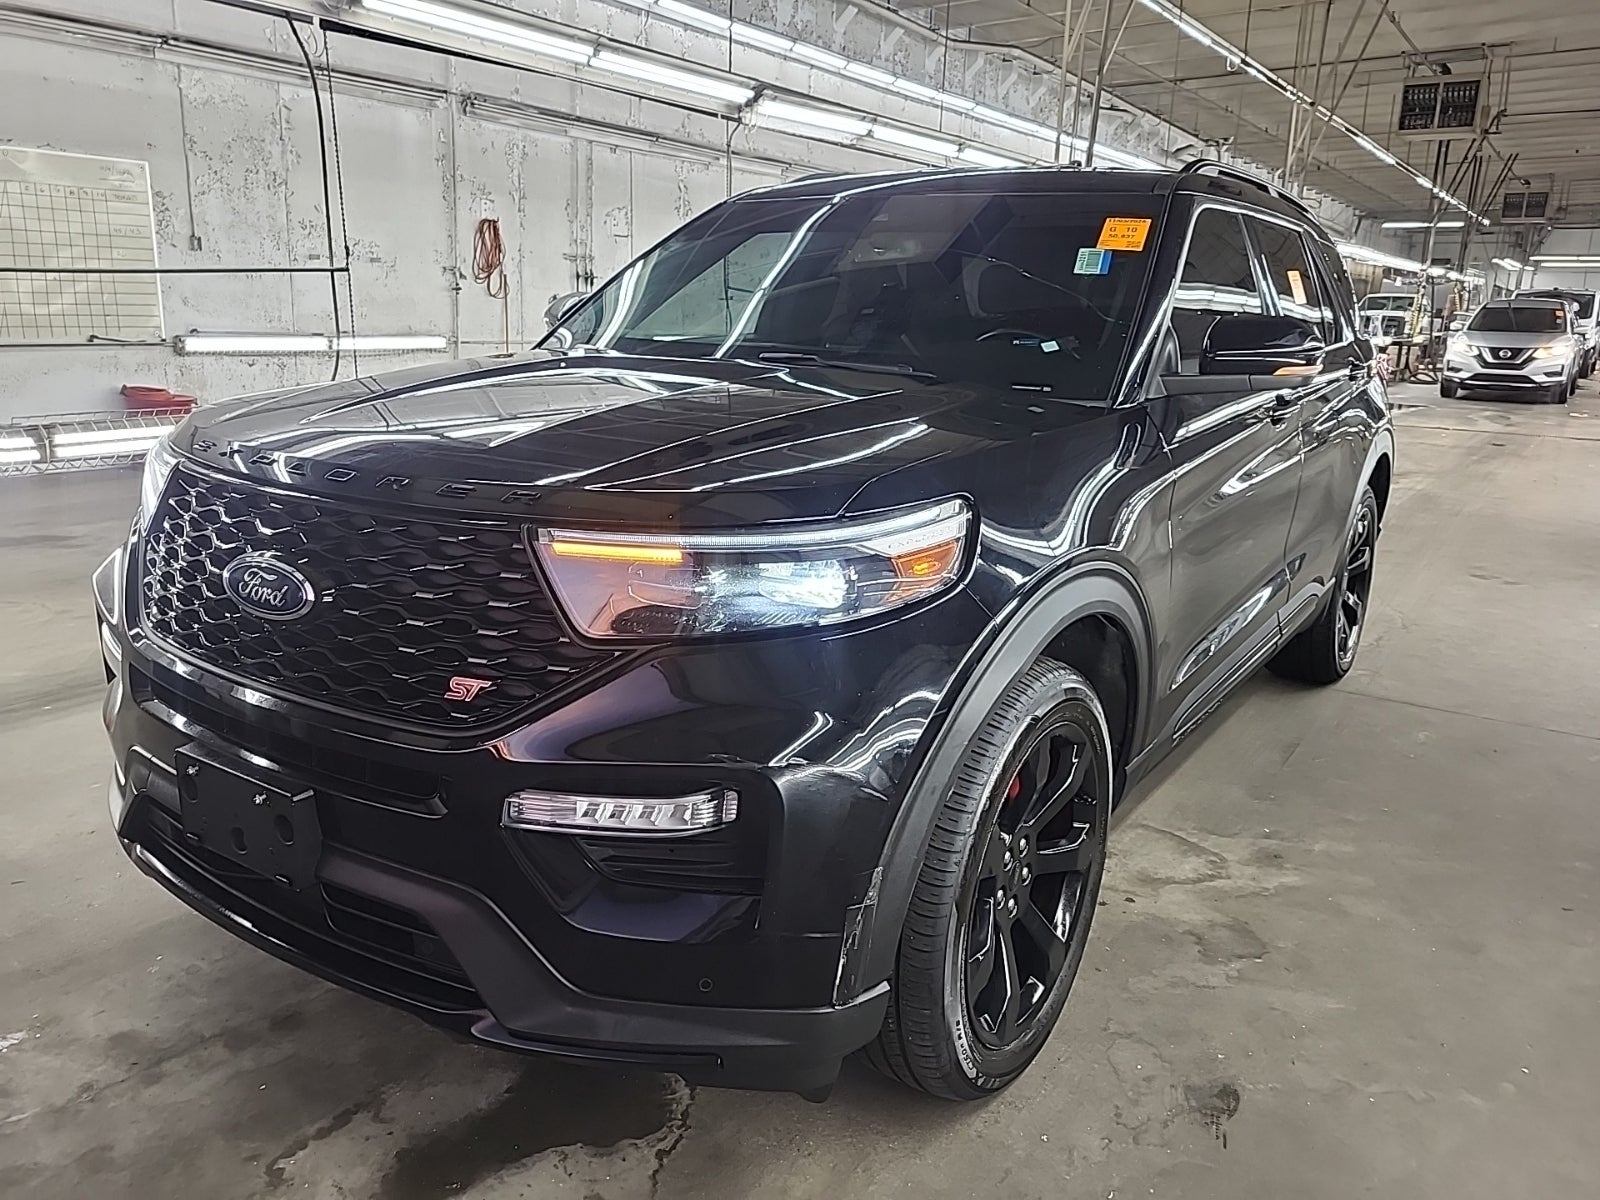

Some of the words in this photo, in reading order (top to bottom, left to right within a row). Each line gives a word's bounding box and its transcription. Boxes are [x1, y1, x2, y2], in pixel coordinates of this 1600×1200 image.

[193, 440, 542, 505] EXPLORER
[239, 567, 289, 608] Ford
[443, 676, 493, 702] ST
